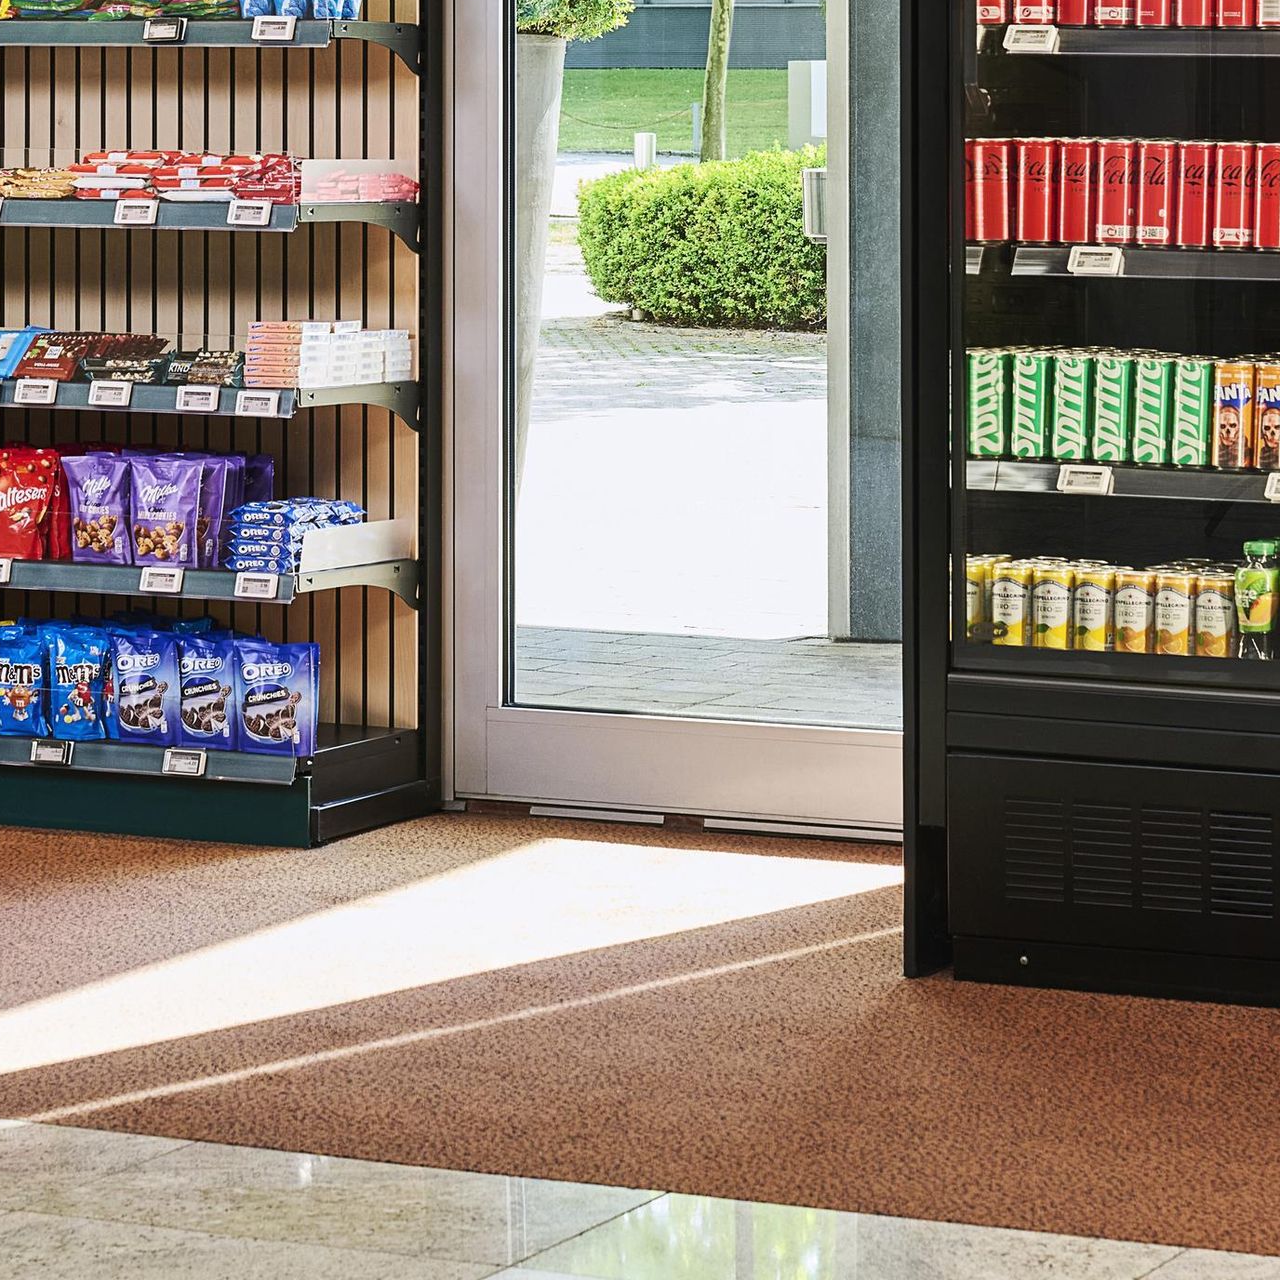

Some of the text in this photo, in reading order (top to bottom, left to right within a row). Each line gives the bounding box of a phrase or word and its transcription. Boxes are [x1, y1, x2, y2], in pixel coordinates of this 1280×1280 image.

[168, 362, 190, 373] KIND
[140, 483, 179, 503] Milka
[243, 513, 270, 522] OREO
[241, 529, 269, 537] OREO
[238, 545, 267, 554] OREO
[236, 560, 265, 569] OREO
[117, 654, 160, 670] OREO
[181, 658, 222, 673] OREO
[243, 664, 291, 680] OREO
[121, 680, 154, 693] CRUNCHIES
[184, 683, 218, 696] CRUNCHIES
[248, 690, 286, 702] CRUNCHIES
